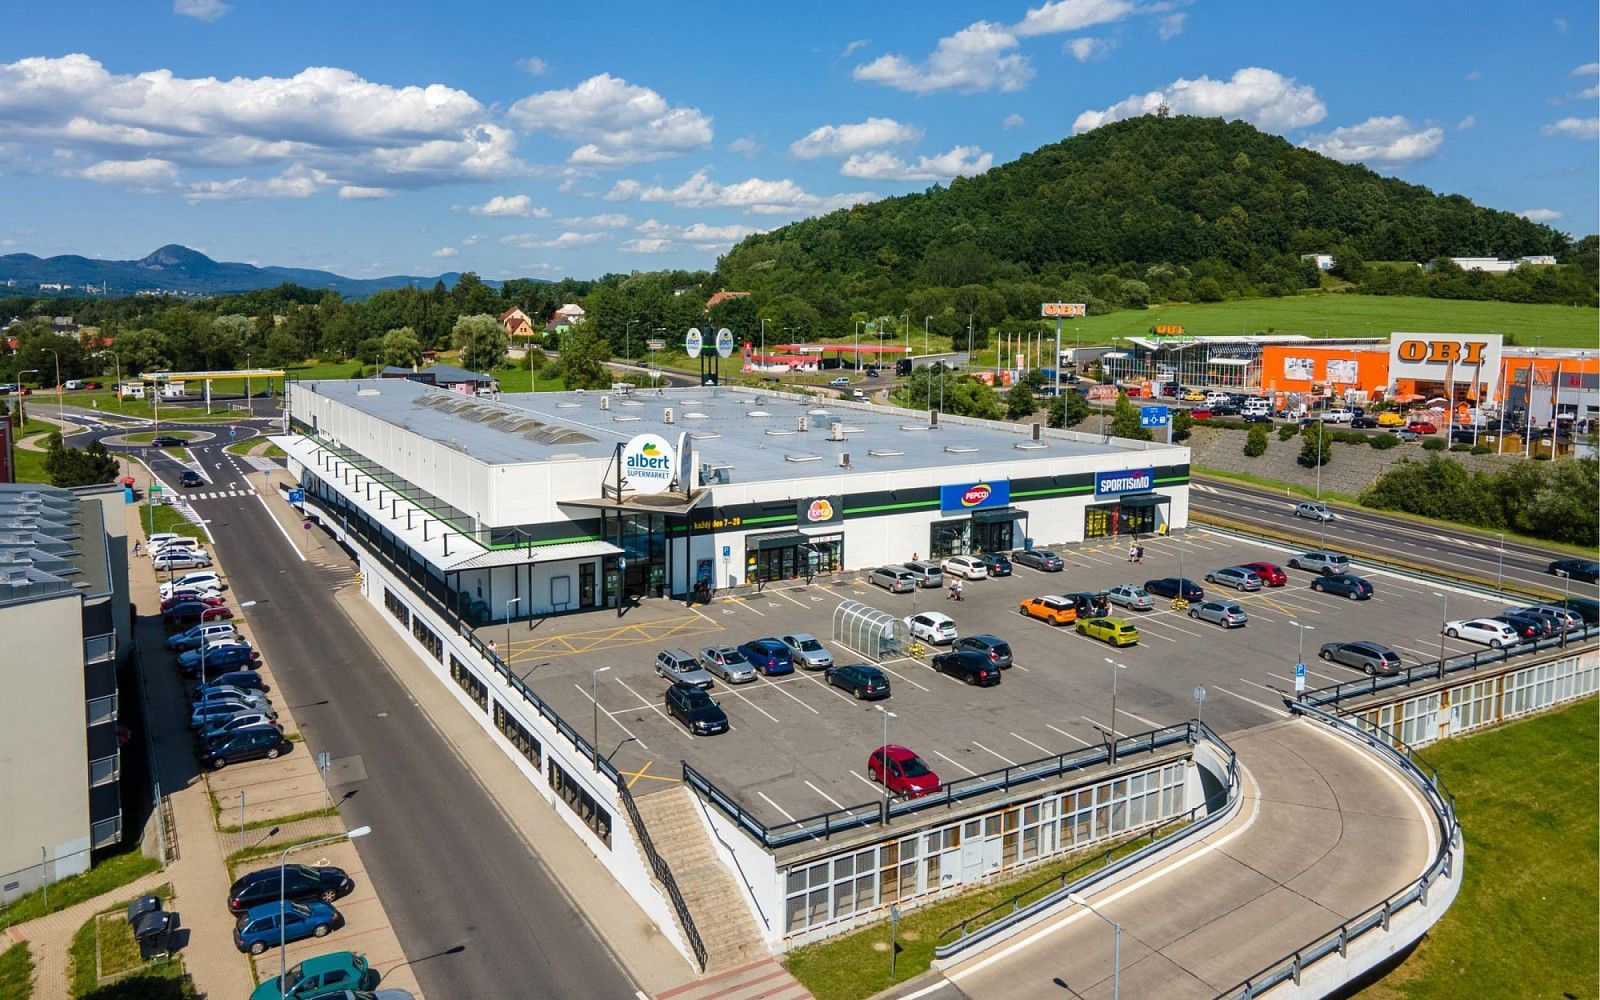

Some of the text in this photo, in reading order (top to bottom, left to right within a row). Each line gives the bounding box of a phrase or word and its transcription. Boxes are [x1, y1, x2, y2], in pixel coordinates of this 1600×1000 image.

[1044, 304, 1085, 316] OBI
[1398, 340, 1488, 364] OBI
[627, 453, 670, 469] albert
[627, 470, 670, 479] SUPERMARKET
[965, 491, 987, 500] PEPCO
[713, 519, 724, 528] den
